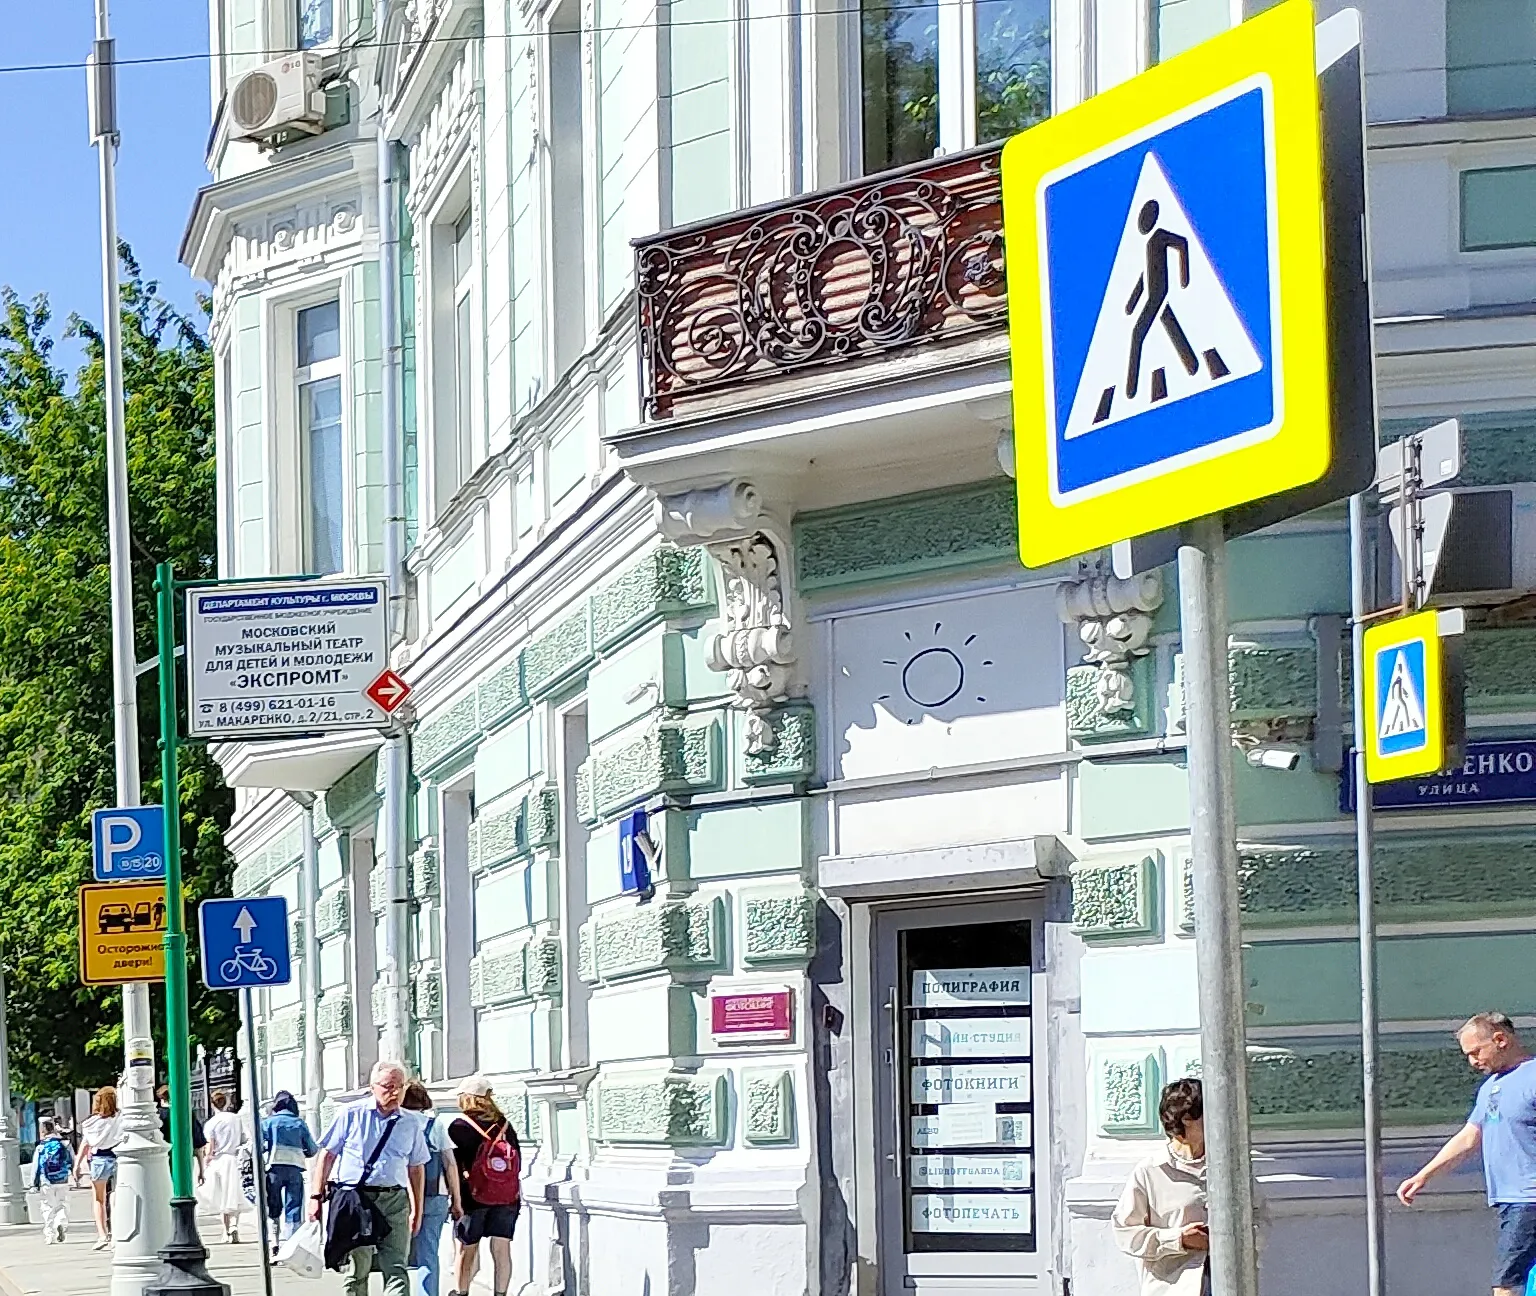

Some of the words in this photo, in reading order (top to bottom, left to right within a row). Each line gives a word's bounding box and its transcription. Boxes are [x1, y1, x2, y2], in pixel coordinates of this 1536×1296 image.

[241, 621, 336, 640] МОСКОВСКИЙ
[215, 637, 322, 656] МУЗЫКАЛЬНЫЙ
[326, 637, 363, 649] ТЕАТР
[205, 659, 234, 674] ДЛЯ
[236, 655, 278, 672] ДЕТЕЙ
[281, 656, 291, 668] И
[293, 651, 374, 666] МОЛОДЕЖИ
[230, 669, 349, 689] «ЭКСПРОМТ»
[219, 702, 228, 713] 8
[231, 700, 266, 714] (499)
[268, 697, 336, 710] 621-01-16
[216, 713, 295, 728] МАКАРЕНКО,
[365, 709, 374, 720] 2
[1418, 782, 1480, 797] УЛИЦА
[101, 816, 141, 872] P
[144, 856, 160, 868] 20
[113, 956, 153, 969] двери!
[922, 980, 1021, 994] ПОЛИГРАФИЯ
[921, 1077, 1020, 1091] ФОТОКНИГИ
[921, 1207, 1020, 1220] ФОТОПЕЧАТЬ
